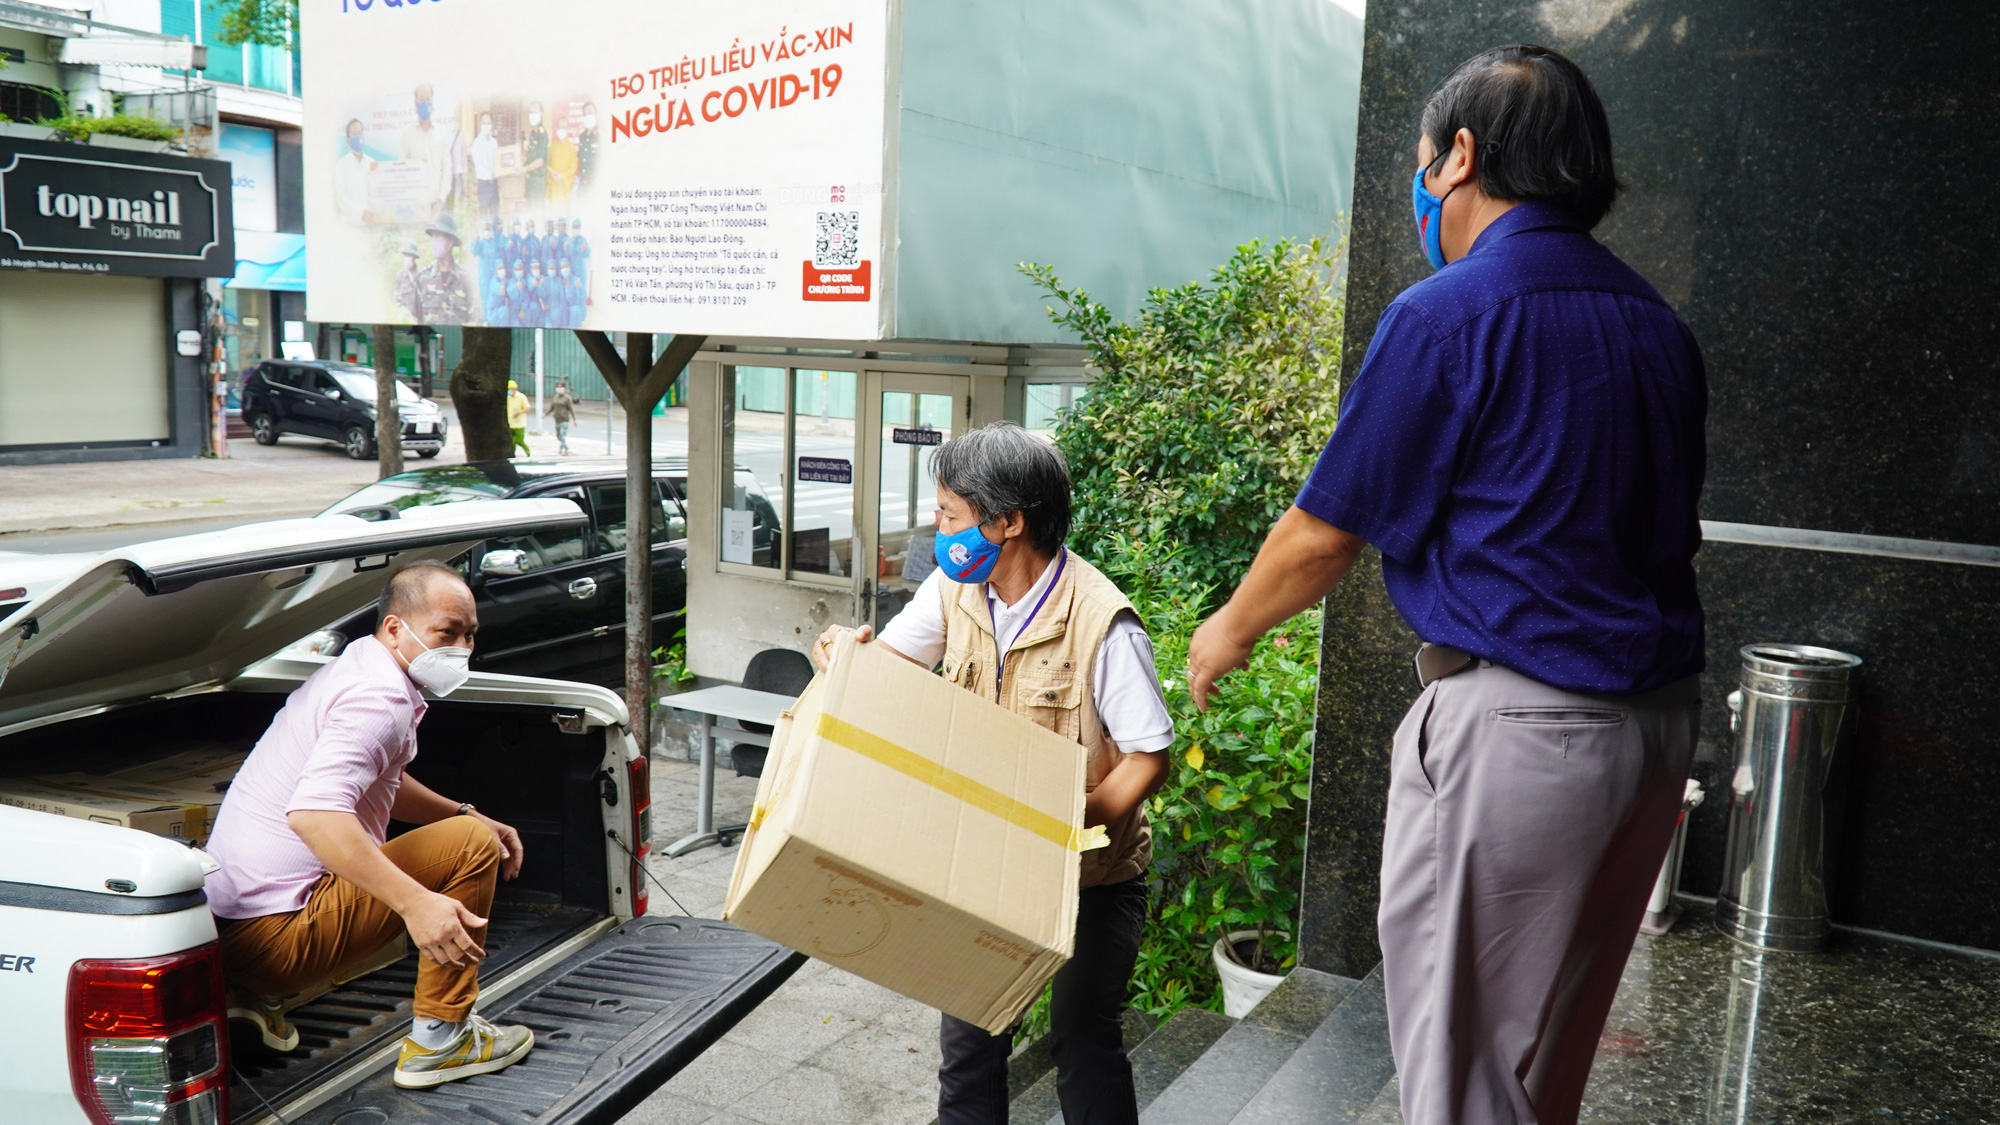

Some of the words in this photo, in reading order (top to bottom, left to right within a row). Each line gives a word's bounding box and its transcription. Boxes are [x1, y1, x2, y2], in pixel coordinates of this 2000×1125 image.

[610, 73, 645, 100] 150
[649, 54, 706, 90] TRIỆU
[711, 37, 756, 77] LIỀU
[761, 21, 853, 63] VẮC-XIN
[611, 91, 696, 143] NGỪA
[701, 63, 843, 122] COVID-19
[669, 188, 680, 197] xin
[36, 184, 103, 230] top
[105, 189, 181, 226] nail
[649, 203, 669, 213] TMCP
[736, 203, 753, 212] Nam
[634, 219, 642, 228] TP
[110, 222, 131, 240] by
[133, 223, 182, 241] Thami
[708, 234, 722, 243] Lao
[628, 264, 650, 276] chung
[819, 273, 832, 283] QR
[832, 273, 854, 283] CODE
[611, 279, 624, 288] 127
[756, 281, 761, 290] 3
[766, 281, 777, 290] TP
[610, 293, 627, 303] HCM
[697, 295, 711, 305] 091
[713, 295, 731, 305] 8101
[733, 296, 747, 306] 209
[0, 953, 36, 973] ER
